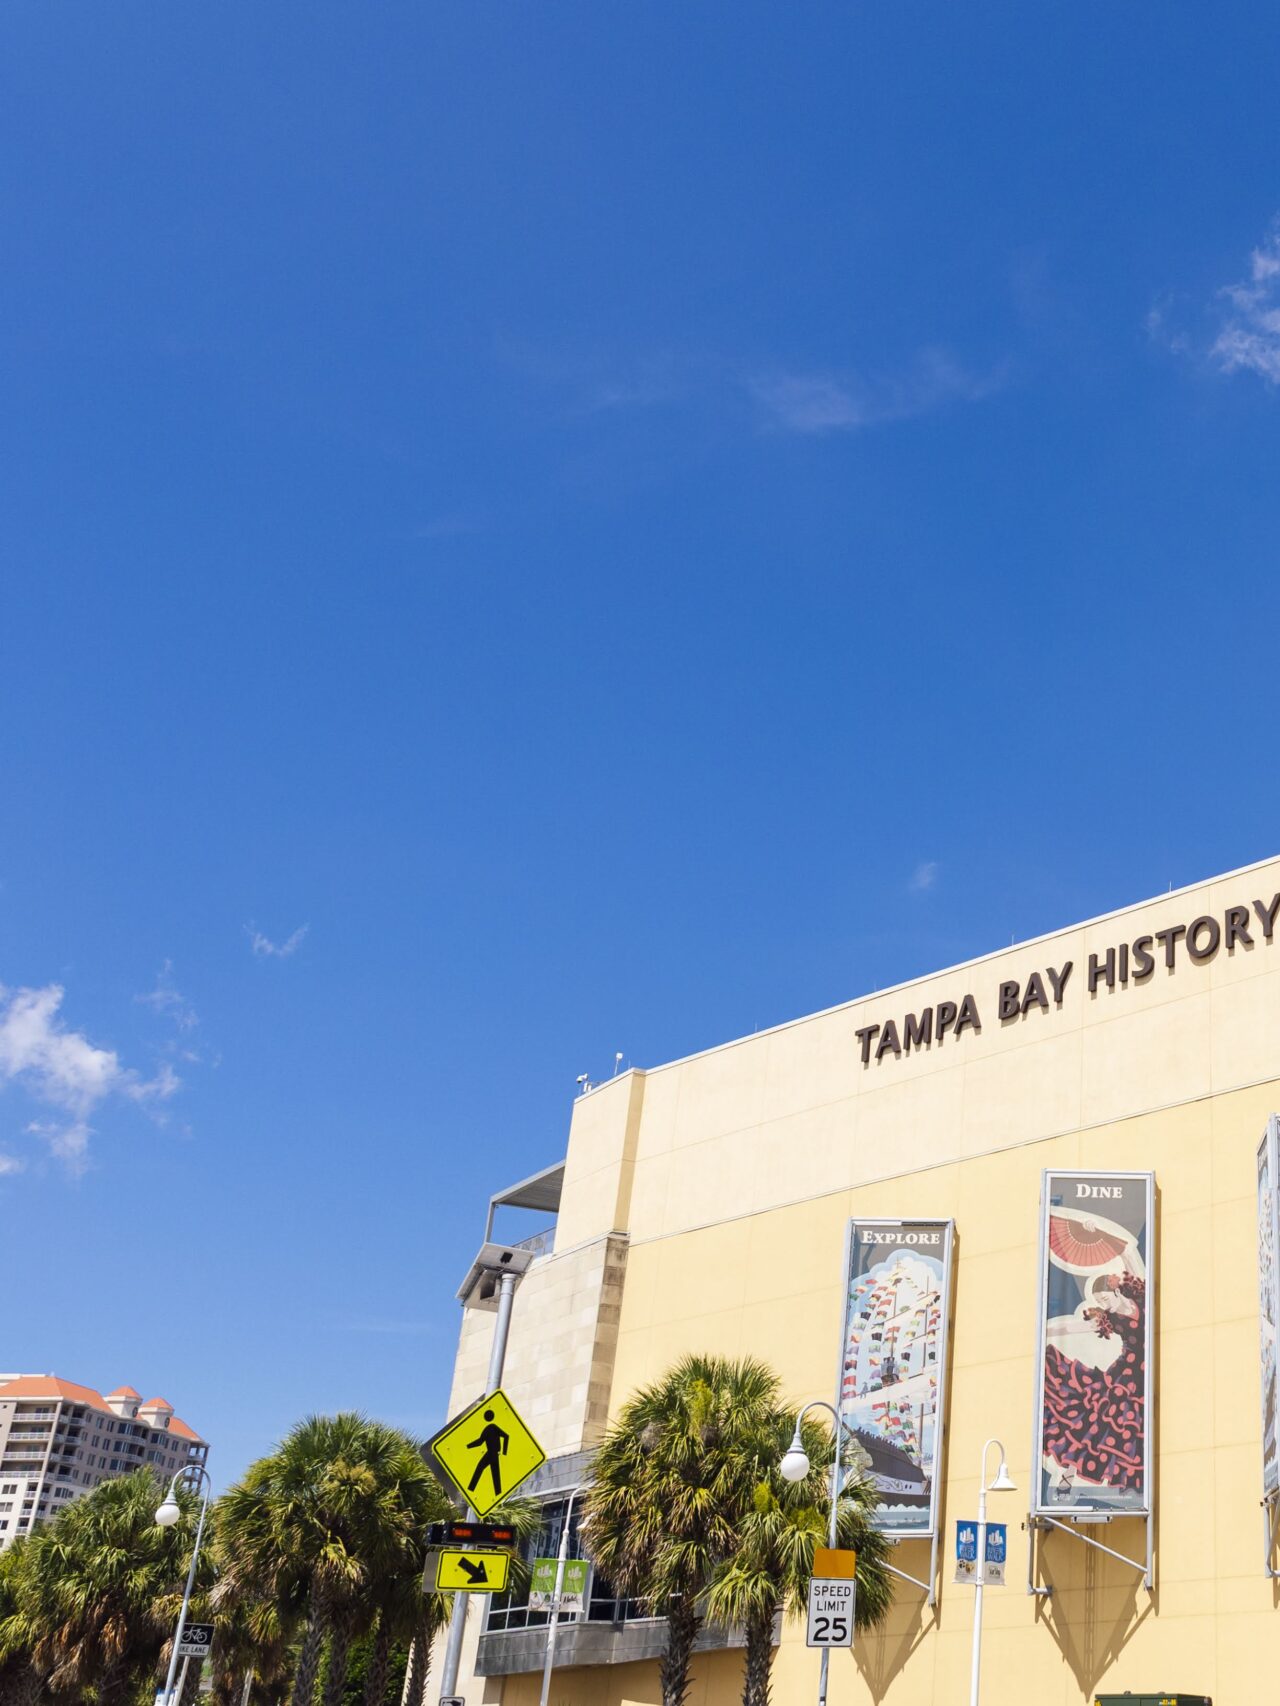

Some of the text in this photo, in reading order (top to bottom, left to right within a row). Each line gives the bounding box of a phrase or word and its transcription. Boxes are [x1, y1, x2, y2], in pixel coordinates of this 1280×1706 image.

[855, 993, 981, 1063] TAMPA
[998, 961, 1073, 1020] BAY
[1075, 1183, 1123, 1199] DINE
[861, 1230, 940, 1245] EXPLORE
[813, 1585, 851, 1597] SPEED
[816, 1600, 847, 1612] LIMIT
[813, 1616, 848, 1642] 25
[178, 1645, 207, 1654] IKE LANE
